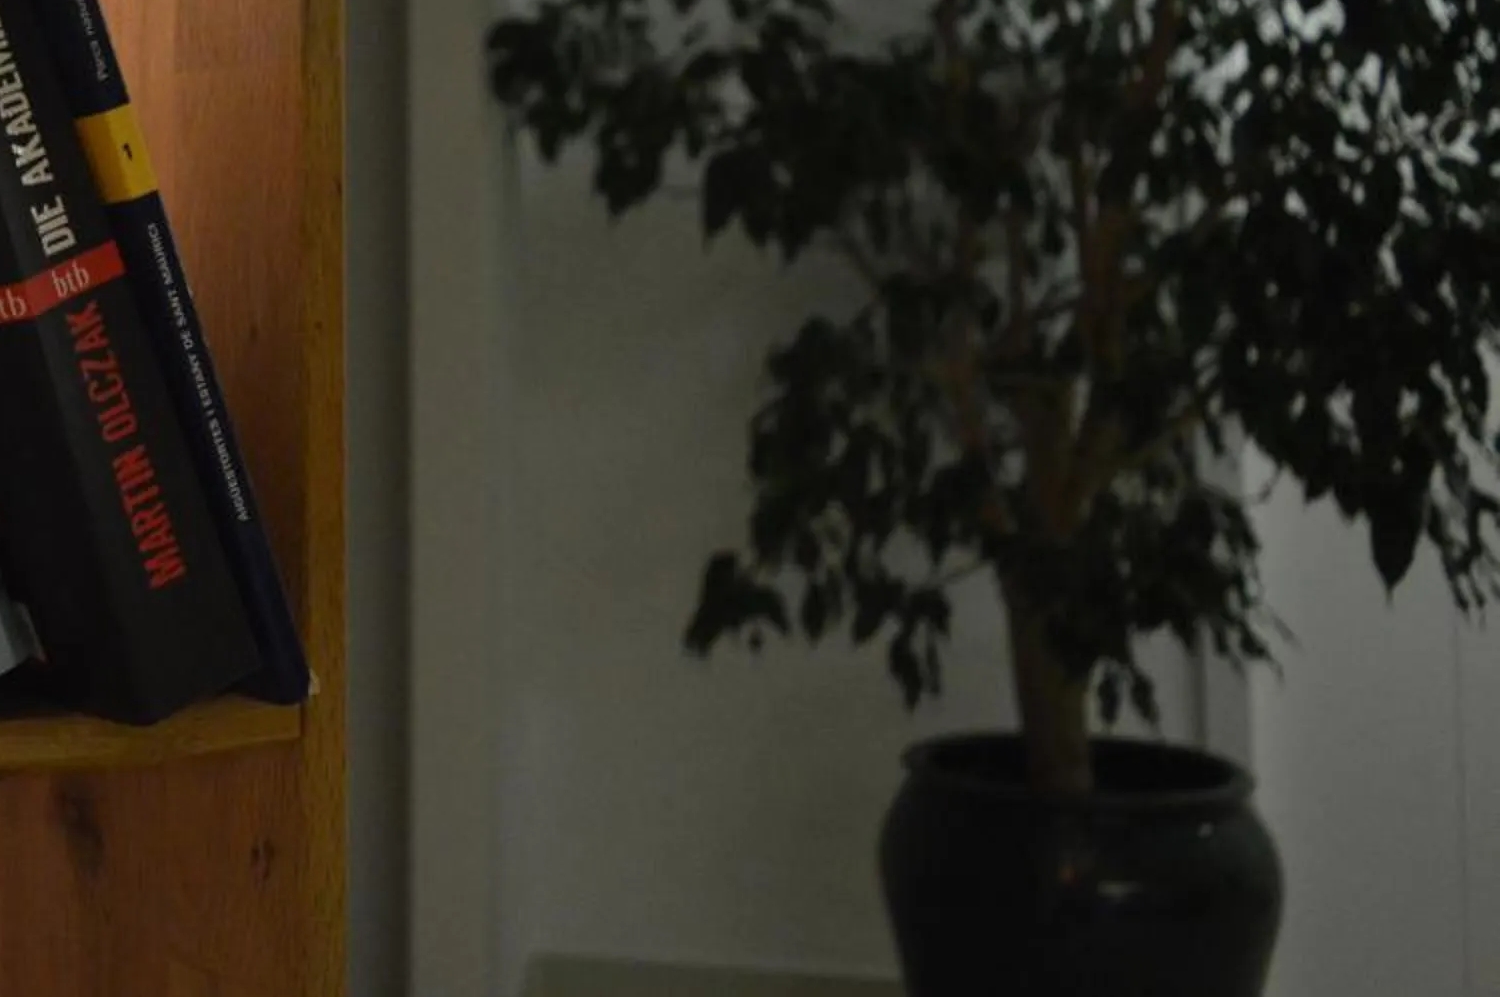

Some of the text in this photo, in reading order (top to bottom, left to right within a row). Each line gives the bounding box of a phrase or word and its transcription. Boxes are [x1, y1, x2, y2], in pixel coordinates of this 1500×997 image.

[30, 195, 77, 257] DIE
[52, 261, 91, 299] btb
[167, 289, 188, 328] SANT
[180, 329, 194, 350] DE
[66, 300, 187, 590] MARTIN OLCZAK
